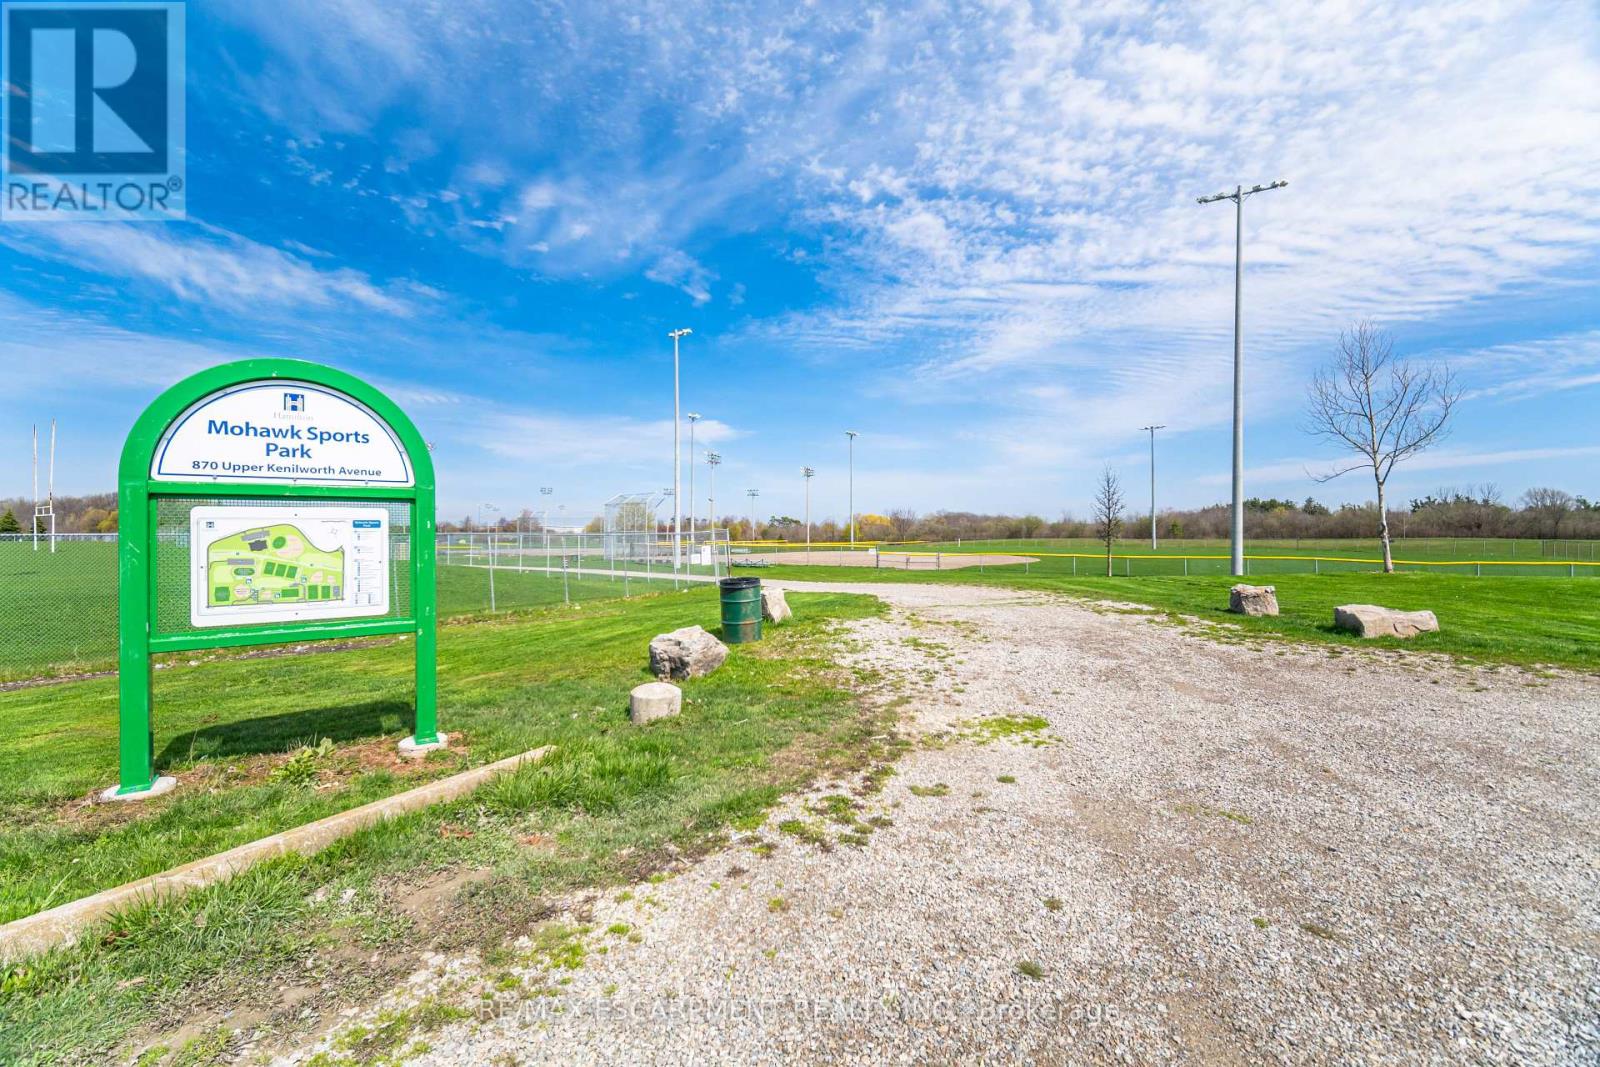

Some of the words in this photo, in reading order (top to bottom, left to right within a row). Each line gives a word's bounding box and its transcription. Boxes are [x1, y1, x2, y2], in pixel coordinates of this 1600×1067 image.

[208, 420, 302, 440] Mohawk
[307, 427, 370, 445] Sports
[265, 443, 313, 459] Park
[192, 461, 218, 471] 870
[221, 462, 264, 476] Upper
[267, 464, 335, 475] Kenilworth
[338, 467, 382, 477] Avenue
